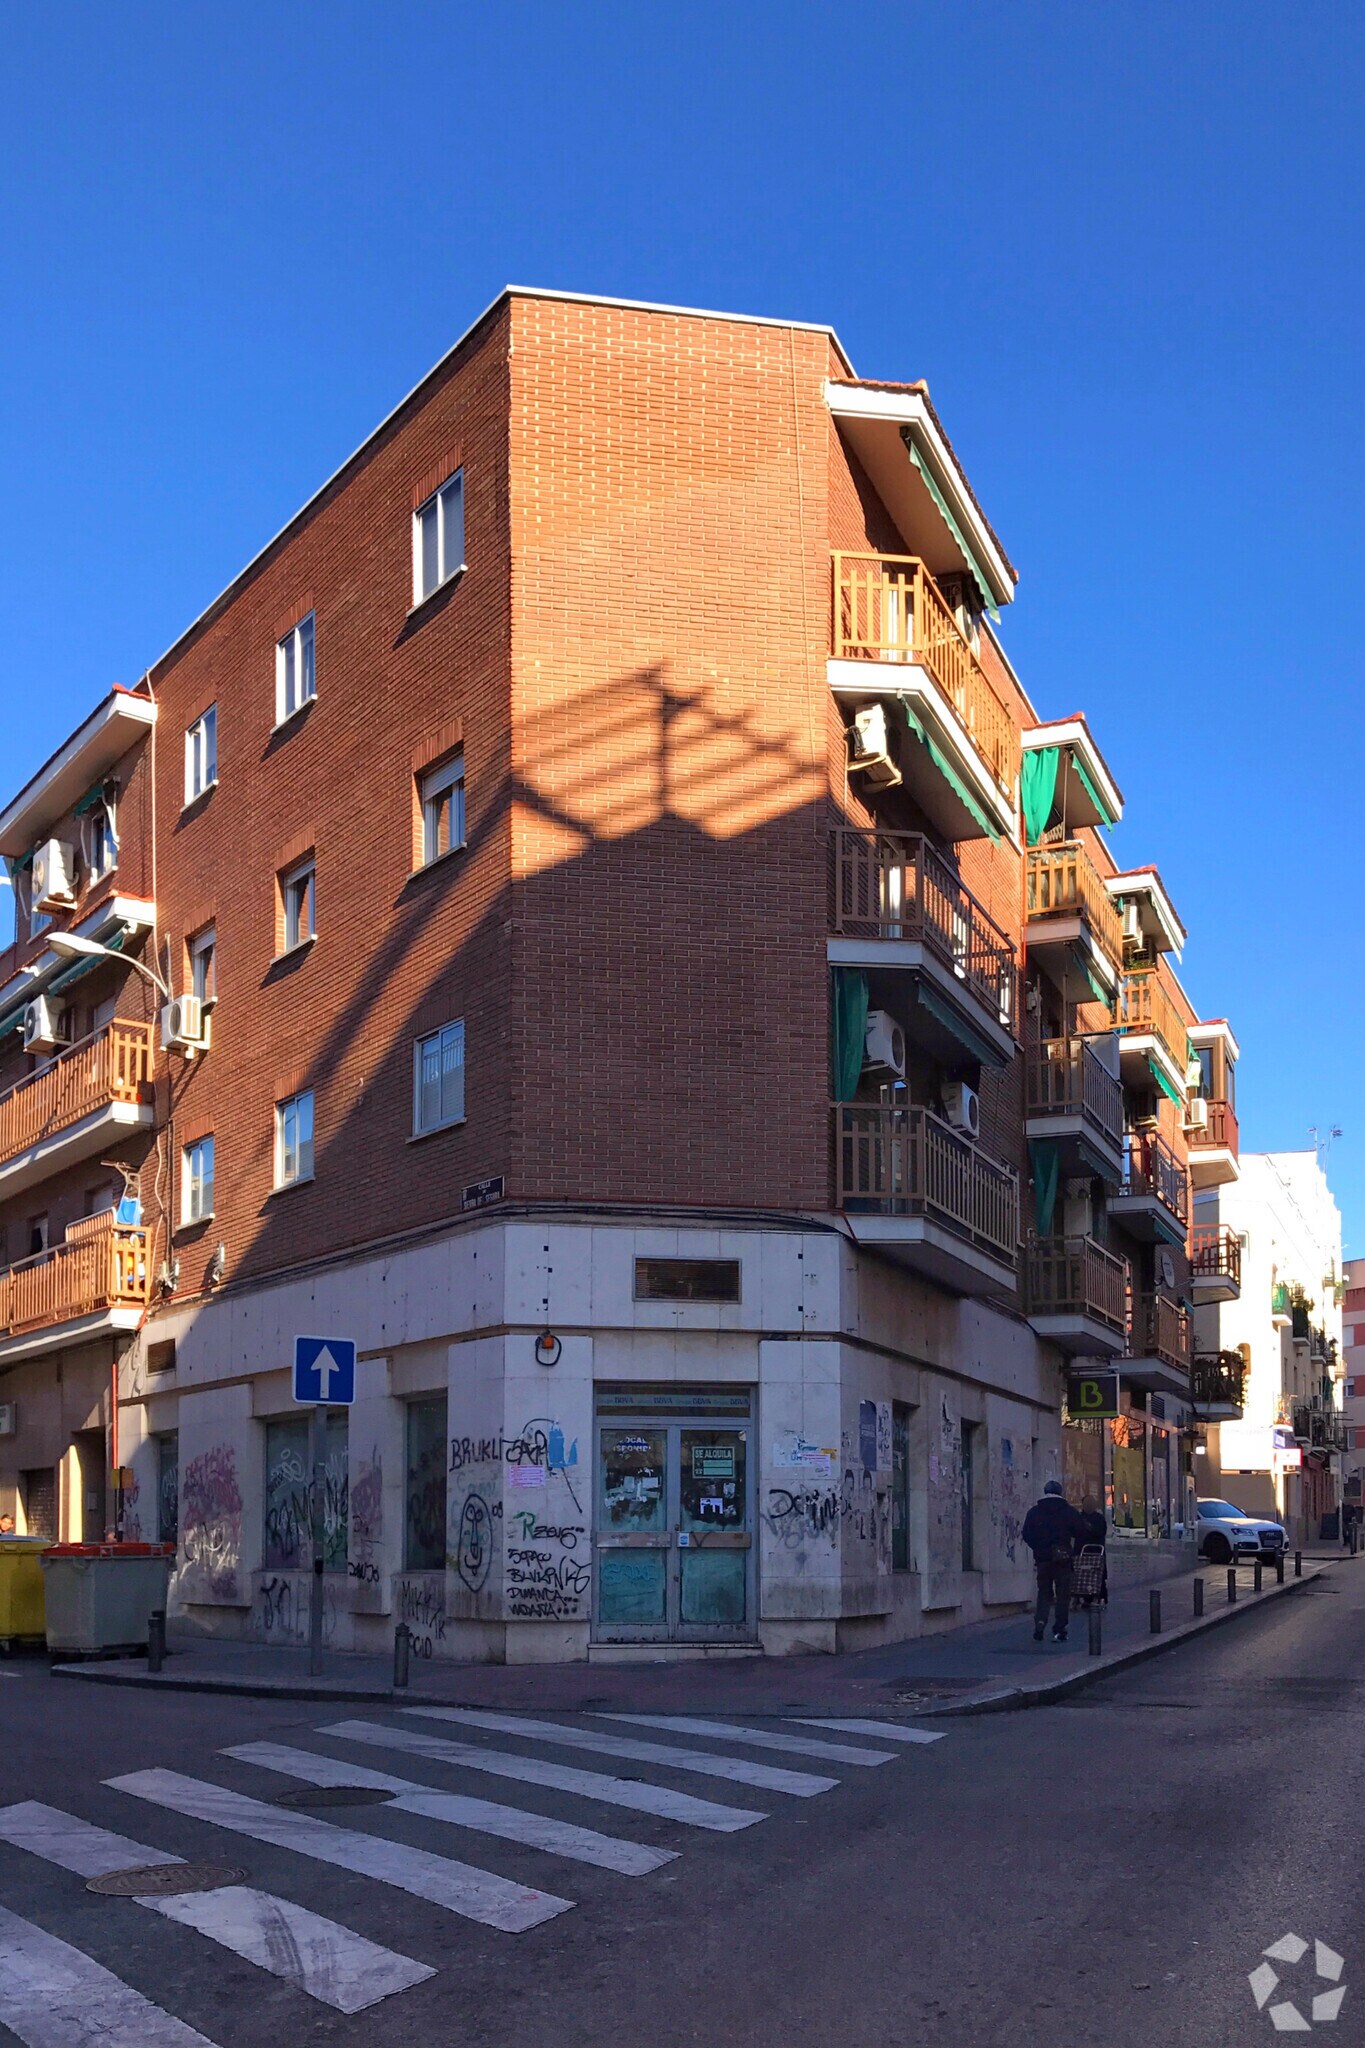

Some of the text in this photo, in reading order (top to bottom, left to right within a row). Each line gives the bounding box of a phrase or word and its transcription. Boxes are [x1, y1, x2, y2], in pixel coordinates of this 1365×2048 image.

[1080, 1381, 1103, 1408] B
[695, 1449, 732, 1459] SE ALQUILA
